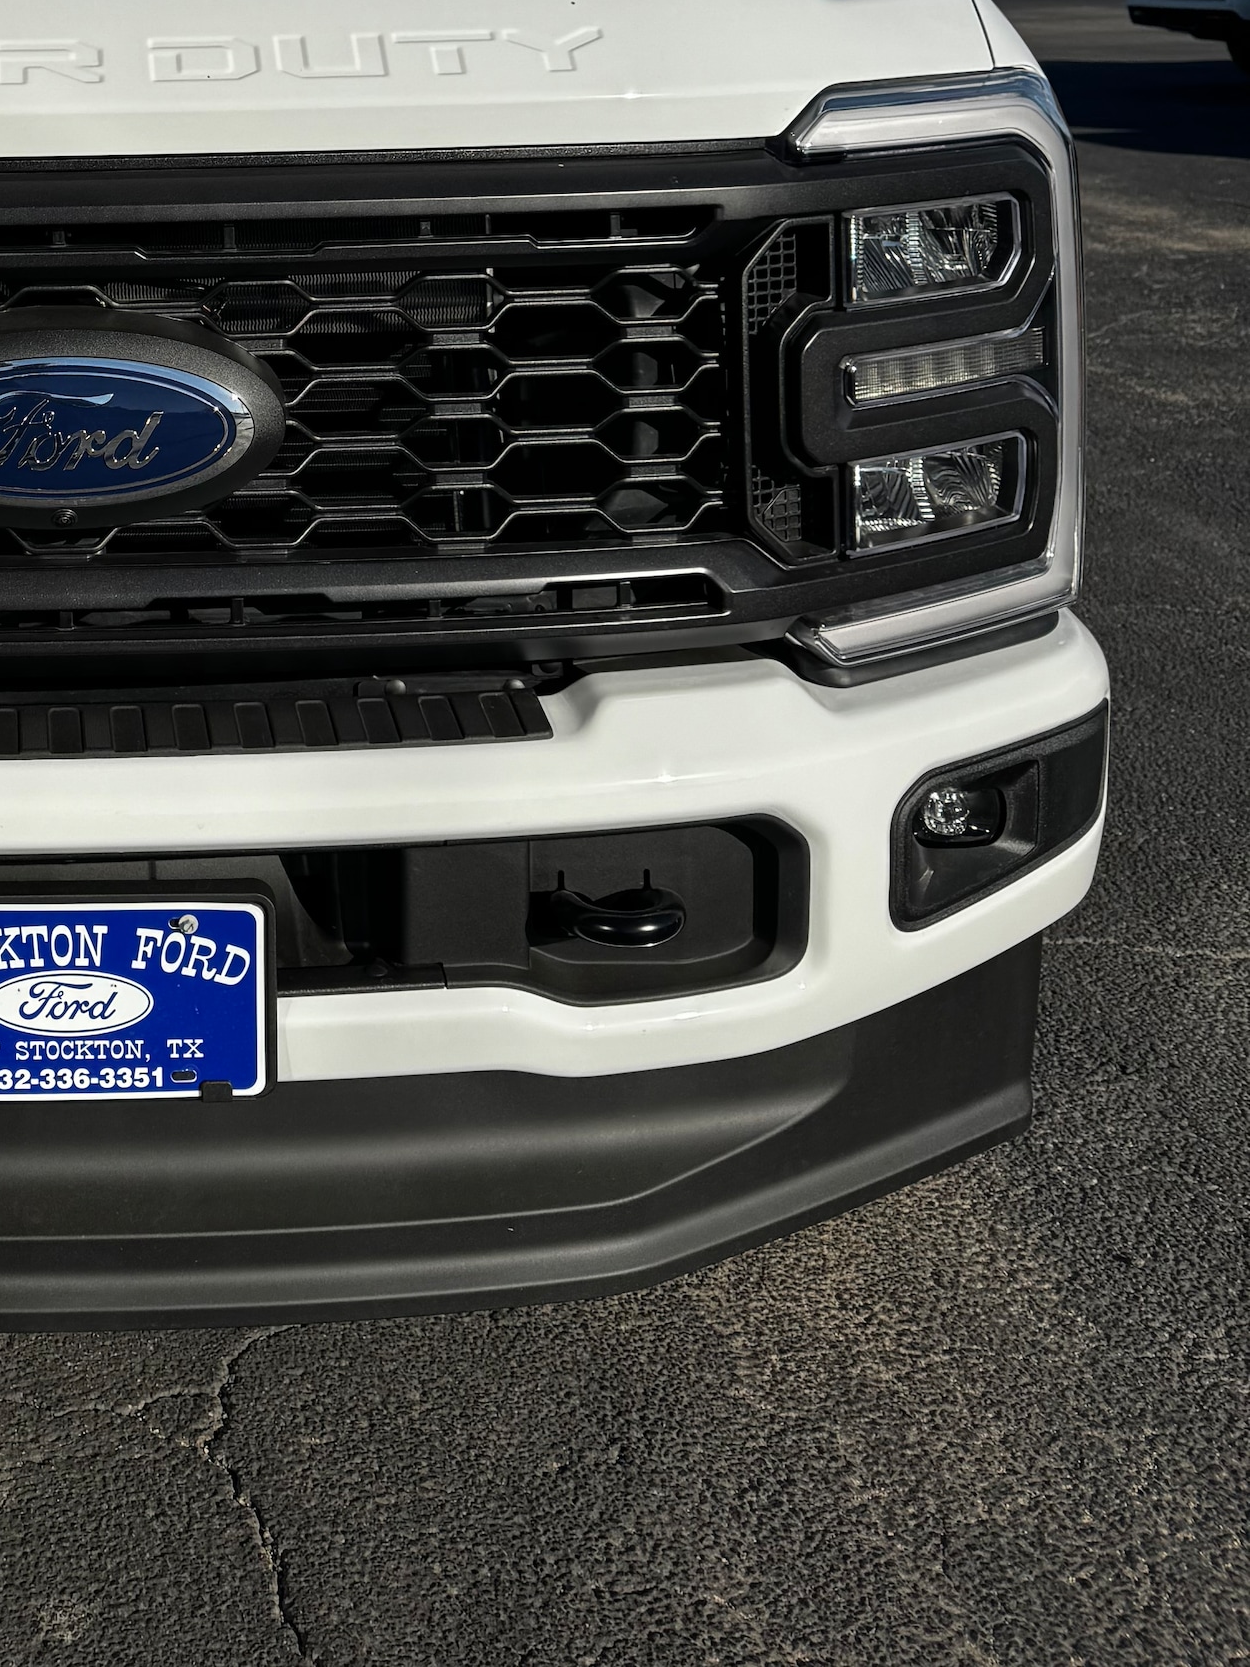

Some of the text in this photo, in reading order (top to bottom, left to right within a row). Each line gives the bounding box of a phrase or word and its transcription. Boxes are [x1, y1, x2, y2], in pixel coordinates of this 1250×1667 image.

[147, 26, 604, 82] DUTY
[131, 927, 251, 986] FORD
[18, 981, 119, 1021] Ford
[15, 1039, 151, 1063] STOCKTON,
[166, 1039, 205, 1059] TX
